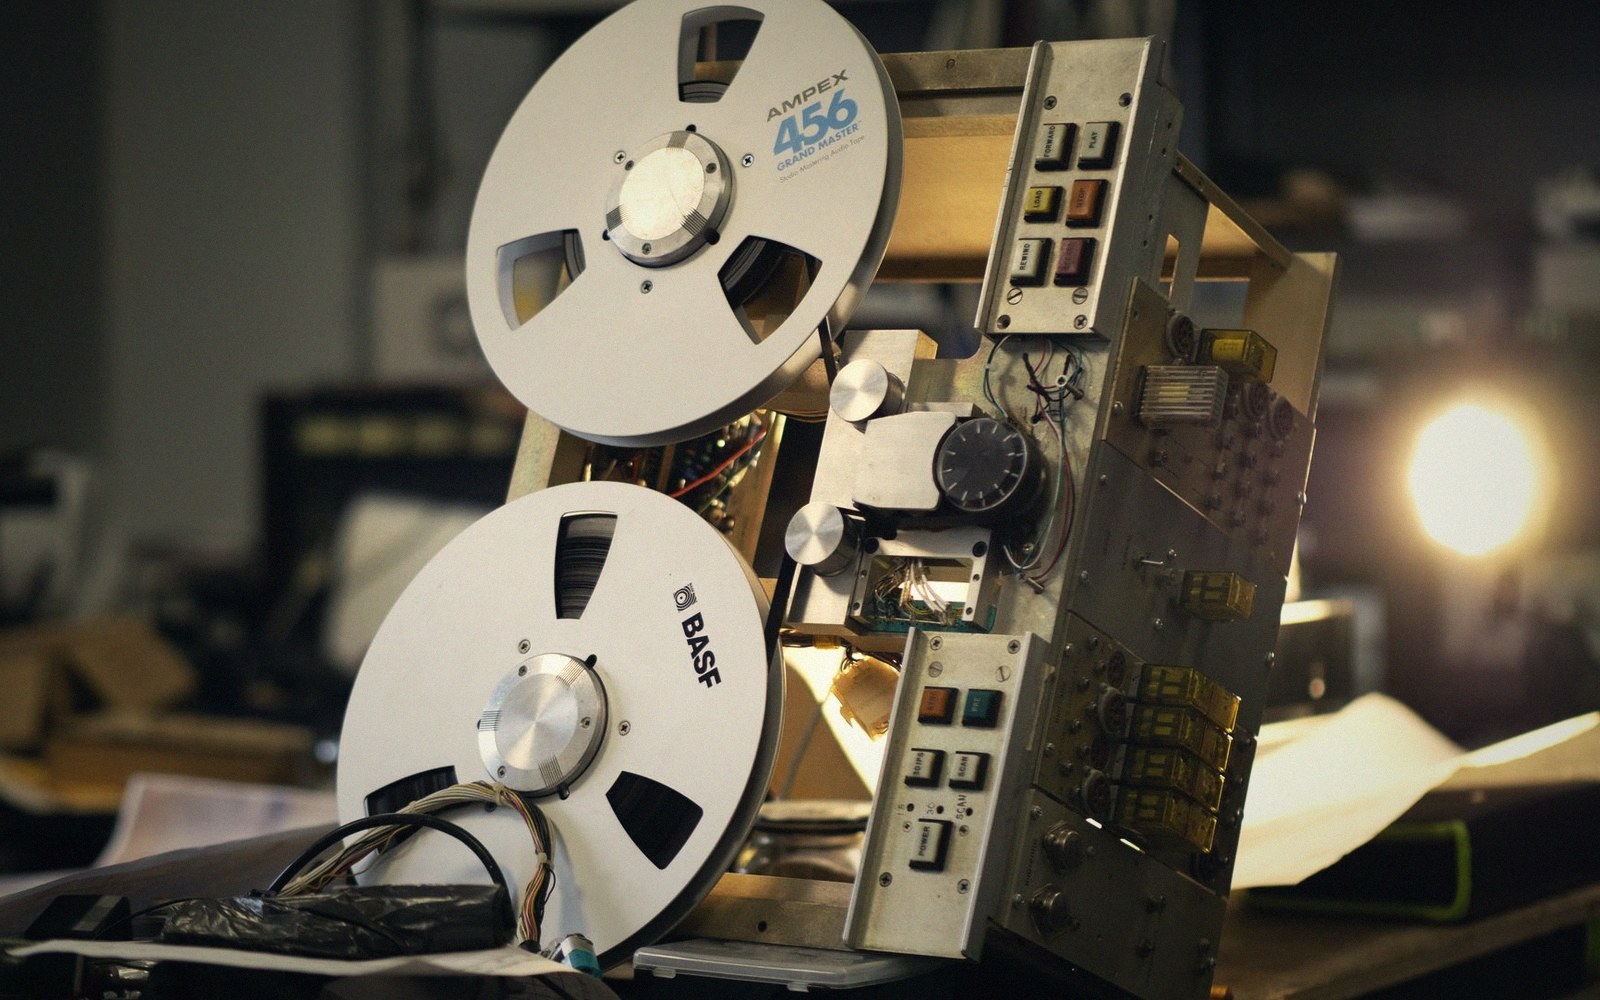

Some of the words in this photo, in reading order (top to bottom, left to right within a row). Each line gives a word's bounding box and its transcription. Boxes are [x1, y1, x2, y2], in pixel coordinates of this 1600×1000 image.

[767, 69, 849, 122] AMPEX
[773, 88, 858, 156] 456
[777, 146, 815, 171] GRAND
[818, 123, 859, 150] MASTER
[1044, 125, 1056, 158] FORWARD
[1088, 131, 1098, 149] PLAY
[780, 170, 799, 183] Studio
[800, 154, 830, 173] Mastering
[831, 143, 849, 157] Audio
[850, 135, 865, 147] Tape
[1033, 190, 1042, 208] LOAD
[1019, 243, 1031, 271] REWIND
[682, 612, 722, 689] BASF
[958, 756, 969, 777] SCAN
[956, 794, 967, 820] SCAN
[918, 826, 930, 856] POWER
